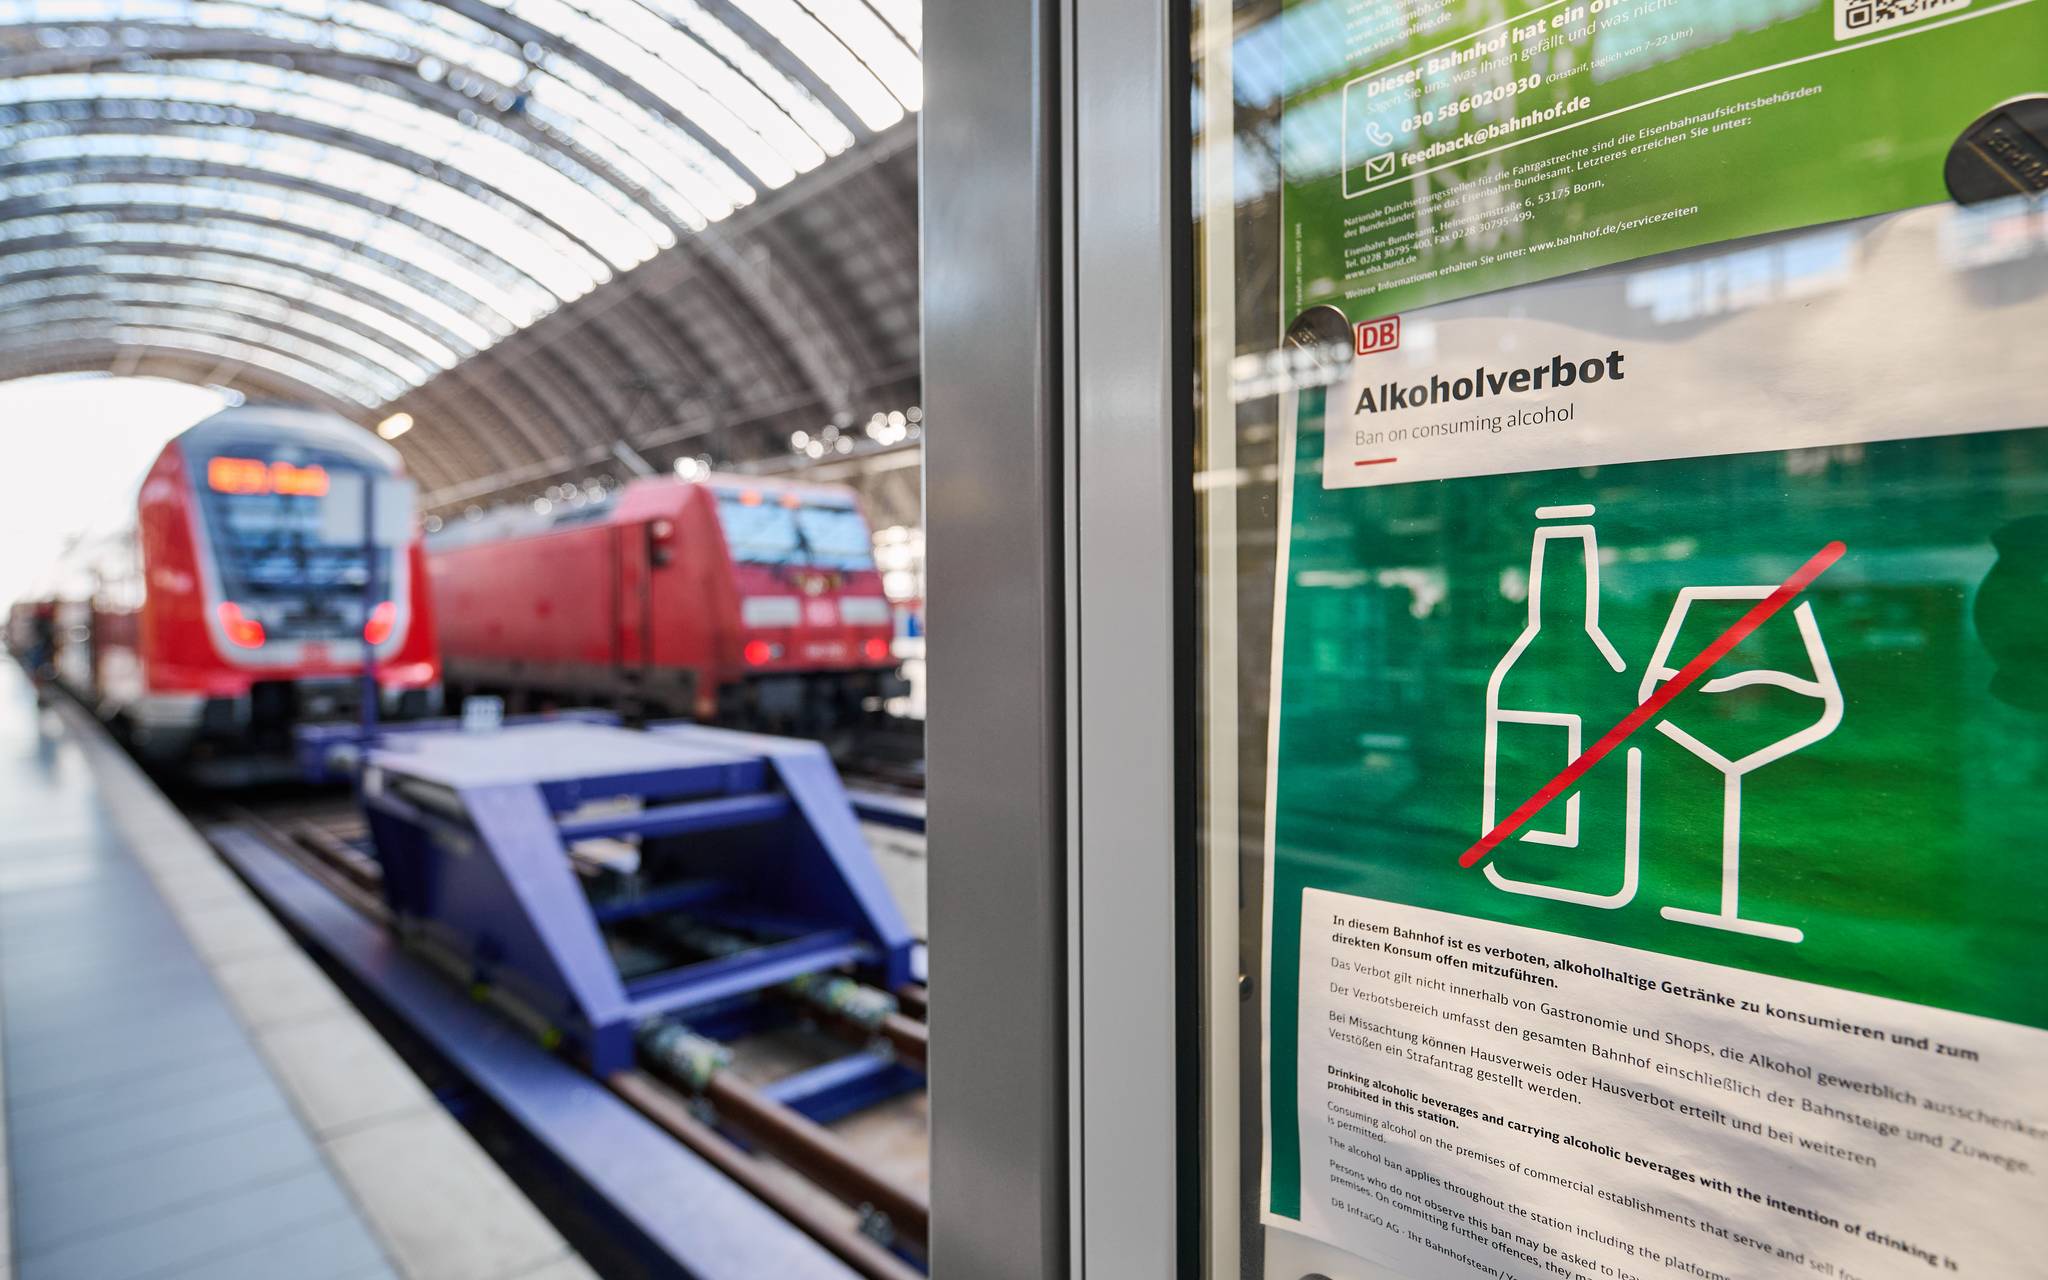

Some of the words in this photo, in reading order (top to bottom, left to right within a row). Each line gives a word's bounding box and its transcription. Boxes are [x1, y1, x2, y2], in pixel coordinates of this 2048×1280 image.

[1367, 67, 1424, 98] Dieser
[1427, 30, 1508, 75] Bahnhof
[1513, 18, 1547, 44] hat
[1551, 6, 1584, 29] ein
[1452, 68, 1477, 83] was
[1480, 52, 1518, 74] Ihnen
[1521, 31, 1564, 62] gefällt
[1565, 10, 1599, 42] und
[1600, 11, 1629, 30] was
[1402, 111, 1433, 132] 030
[1437, 73, 1541, 122] 586020930
[1623, 46, 1642, 57] von
[1512, 147, 1589, 176] Fahrgastrechte
[1591, 137, 1615, 153] sind
[1617, 133, 1636, 145] die
[1638, 85, 1822, 139] Eisenbahnaufsichtsbehörden
[1400, 95, 1591, 168] feedback@bahnhof.de
[1576, 149, 1627, 171] Letzteres
[1630, 133, 1686, 155] erreichen
[1690, 127, 1709, 139] Sie
[1712, 117, 1752, 134] unter:
[1537, 187, 1570, 205] 53175
[1573, 180, 1605, 194] Bonn,
[1377, 270, 1438, 292] Informationen
[1439, 260, 1478, 276] erhalten
[1479, 255, 1494, 266] Sie
[1496, 248, 1526, 262] unter:
[1528, 206, 1698, 254] www.bahnhof.de/servicezeiten
[1361, 322, 1396, 350] DB
[1354, 350, 1625, 415] Alkoholverbot
[1355, 430, 1384, 446] Ban
[1387, 428, 1407, 442] on
[1411, 415, 1502, 439] consuming
[1506, 403, 1574, 428] alcohol
[1331, 932, 1380, 951] direkten
[1383, 942, 1432, 962] Konsum
[1435, 954, 1468, 970] offen
[1471, 962, 1558, 989] mitzuführen.
[1332, 915, 1345, 927] In
[1347, 918, 1389, 935] diesem
[1393, 926, 1445, 946] Bahnhof
[1447, 936, 1463, 950] ist
[1466, 943, 1481, 953] es
[1484, 946, 1550, 969] verboten,
[1553, 958, 1657, 992] alkoholhaltige
[1660, 981, 1735, 1008] Getränke
[1740, 1000, 1759, 1014] zu
[1765, 1003, 1885, 1041] konsumieren
[1891, 1034, 1929, 1051] und
[1935, 1044, 1979, 1062] zum
[1328, 1028, 1382, 1052] Verstößen
[1385, 1045, 1403, 1057] ein
[1406, 1048, 1474, 1079] Strafantrag
[1476, 1070, 1523, 1090] gestellt
[1527, 1082, 1581, 1105] werden.
[1352, 988, 1438, 1017] Verbotsbereich
[1442, 1011, 1490, 1030] umfasst
[1494, 1021, 1518, 1036] den
[1522, 1029, 1586, 1053] gesamten
[1591, 1043, 1651, 1069] Bahnhof
[1655, 1062, 1761, 1099] einschließlich
[1766, 1090, 1794, 1108] der
[1801, 1098, 1900, 1137] Bahnsteige
[1906, 1130, 1943, 1148] und
[1353, 962, 1390, 980] Verbot
[1393, 972, 1412, 984] gilt
[1415, 976, 1445, 992] nicht
[1449, 982, 1509, 1006] innerhalb
[1512, 999, 1536, 1012] von
[1540, 1002, 1628, 1034] Gastronomie
[1632, 1027, 1660, 1042] und
[1664, 1032, 1714, 1056] Shops,
[1719, 1046, 1744, 1063] die
[1748, 1053, 1812, 1080] Alkohol
[1816, 1072, 1917, 1106] gewerblich
[1327, 1081, 1379, 1104] prohibited
[1394, 1101, 1415, 1115] this
[1417, 1109, 1459, 1129] station.
[1328, 1010, 1345, 1023] Bei
[1349, 1015, 1418, 1046] Missachtung
[1421, 1034, 1466, 1055] können
[1470, 1046, 1552, 1077] Hausverweis
[1556, 1070, 1588, 1086] oder
[1591, 1076, 1674, 1111] Hausverbot
[1679, 1104, 1726, 1126] erteilt
[1731, 1119, 1762, 1136] und
[1767, 1125, 1793, 1144] bei
[1798, 1138, 1877, 1169] weiteren
[1327, 1064, 1370, 1089] Drinking
[1372, 1080, 1418, 1102] alcoholic
[1421, 1093, 1479, 1119] beverages
[1481, 1113, 1504, 1127] and
[1507, 1120, 1560, 1145] carrying
[1562, 1135, 1621, 1160] alcoholic
[1624, 1151, 1696, 1183] beverages
[1699, 1177, 1732, 1195] with
[1736, 1187, 1762, 1204] the
[1766, 1195, 1839, 1229] intention
[1843, 1224, 1861, 1235] of
[1865, 1231, 1938, 1267] drinking
[1327, 1100, 1379, 1129] Consuming
[1380, 1120, 1417, 1139] alcohol
[1419, 1134, 1432, 1145] on
[1435, 1138, 1453, 1152] the
[1455, 1146, 1505, 1169] premises
[1508, 1162, 1521, 1173] of
[1523, 1167, 1594, 1196] commercial
[1597, 1189, 1696, 1229] establishments
[1700, 1221, 1728, 1240] that
[1733, 1233, 1772, 1254] serve
[1776, 1248, 1805, 1265] and
[1347, 1145, 1381, 1164] alcohol
[1383, 1156, 1403, 1172] ban
[1404, 1167, 1441, 1187] applies
[1443, 1180, 1505, 1211] throughout
[1507, 1203, 1527, 1218] the
[1530, 1212, 1572, 1233] station
[1576, 1225, 1634, 1255] including
[1638, 1247, 1661, 1261] the
[1366, 1176, 1387, 1190] who
[1424, 1199, 1465, 1222] observe
[1467, 1216, 1488, 1231] this
[1490, 1223, 1512, 1240] ban
[1515, 1235, 1540, 1252] may
[1542, 1242, 1558, 1257] be
[1560, 1252, 1596, 1271] asked
[1600, 1264, 1614, 1277] to
[1391, 1200, 1449, 1231] committing
[1450, 1222, 1489, 1246] further
[1491, 1241, 1542, 1269] offences,
[1545, 1261, 1572, 1280] they
[1424, 1238, 1498, 1278] Bahnhofsteam
